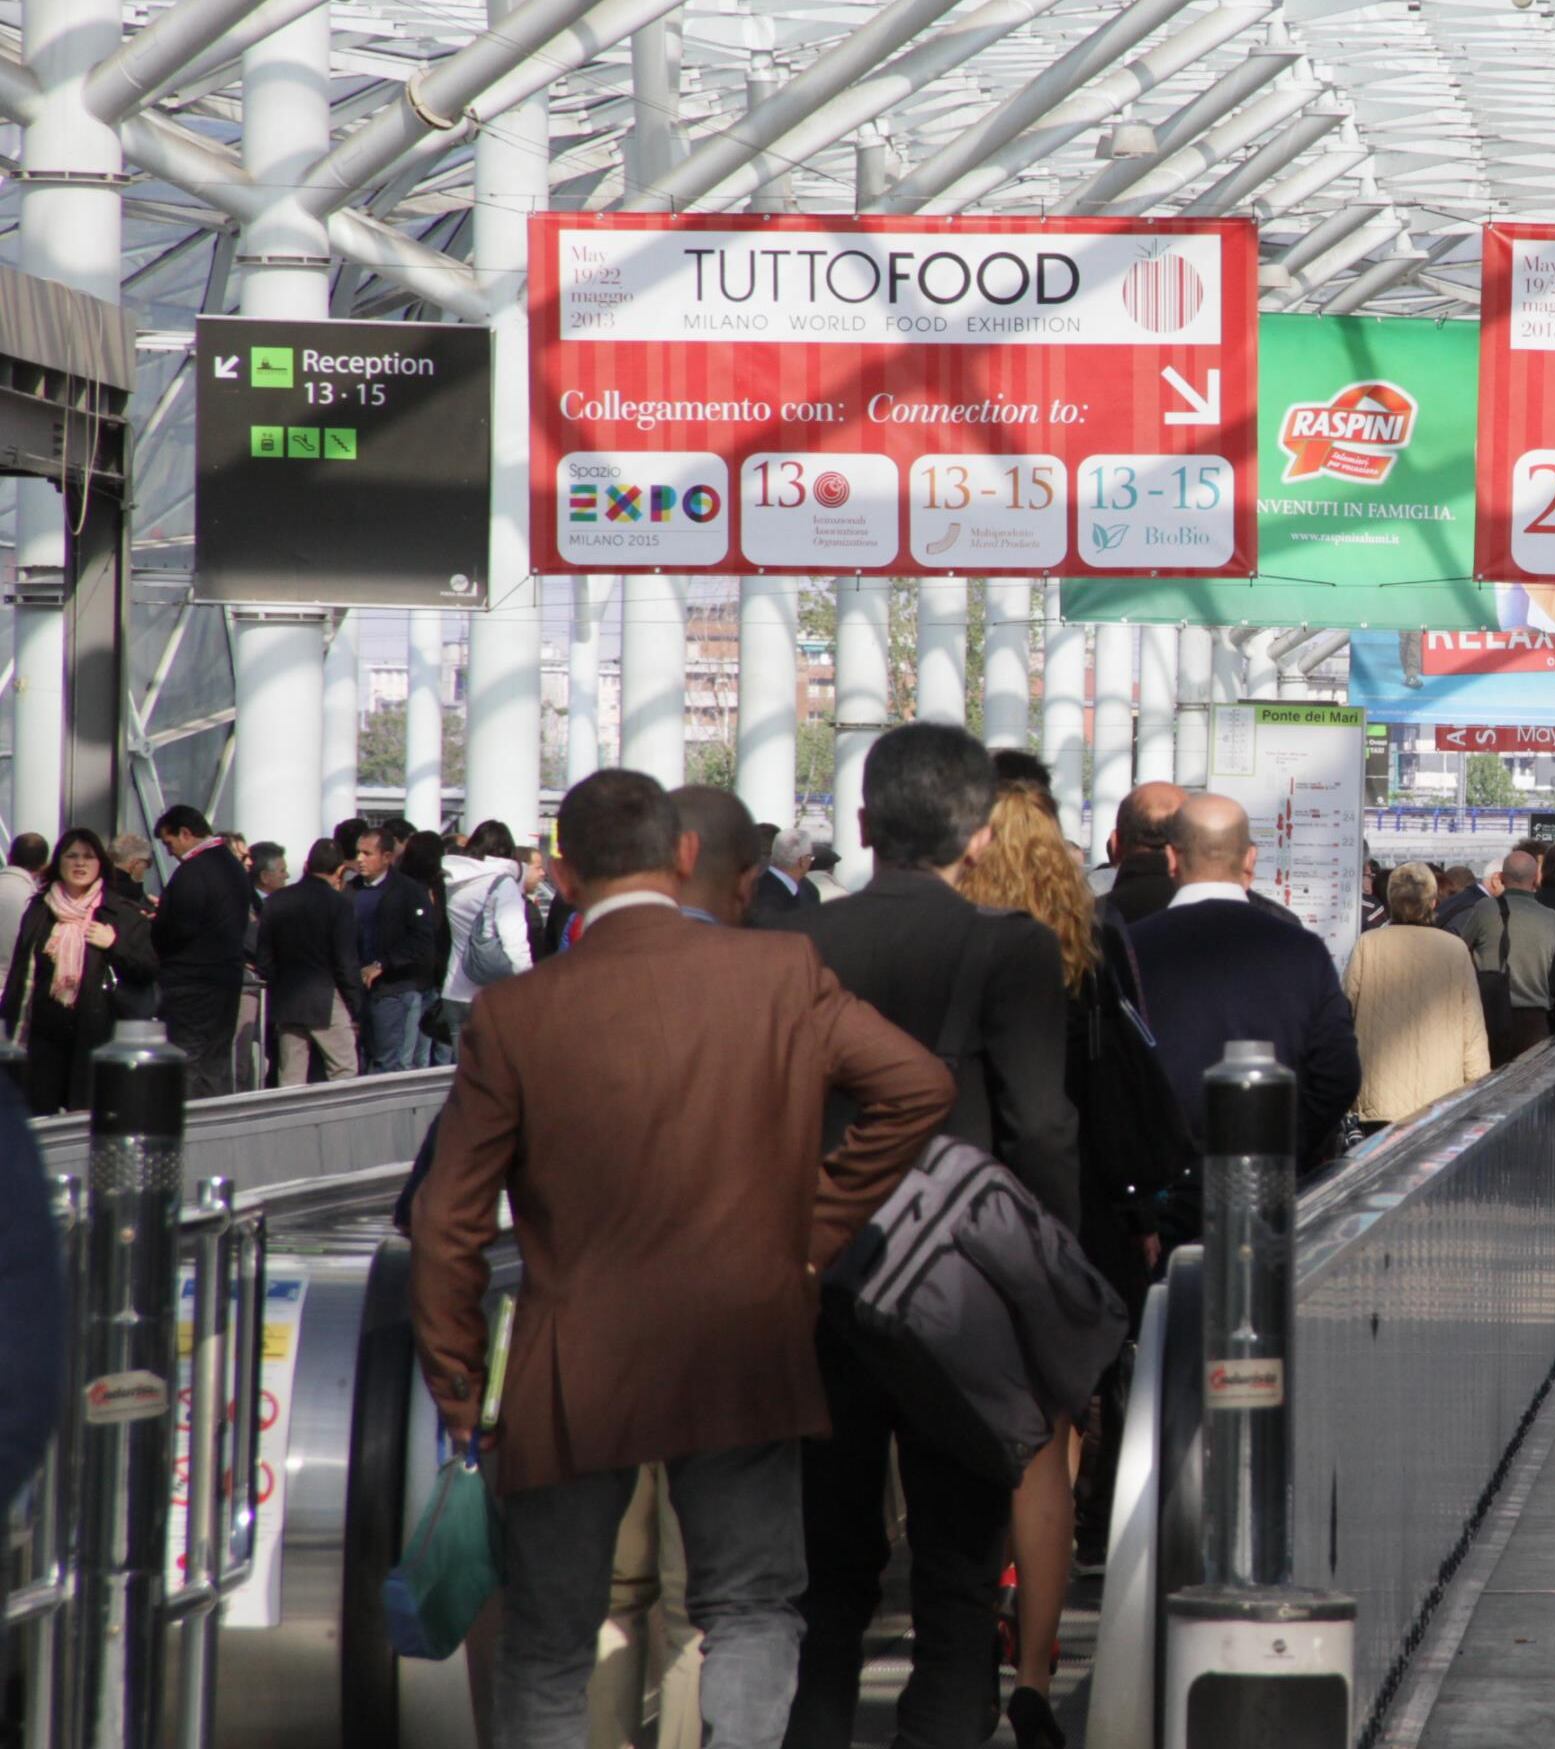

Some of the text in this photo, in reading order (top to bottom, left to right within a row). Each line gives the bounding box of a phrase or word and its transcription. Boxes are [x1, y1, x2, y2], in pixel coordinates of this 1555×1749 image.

[571, 246, 607, 264] May
[574, 267, 622, 285] 19/22
[684, 249, 1080, 305] TUTTOFOOD
[571, 287, 634, 309] maggio
[571, 312, 616, 329] 2013
[684, 315, 1081, 333] MILANO WORLD FOOD EXHIBITION
[302, 350, 434, 379] Reception
[304, 382, 334, 405] 13
[356, 384, 386, 406] 15
[560, 389, 1089, 431] Collegamento con: Connection to:
[1292, 410, 1404, 441] RASPINI
[569, 463, 621, 480] Spazio
[753, 460, 806, 508] 13
[569, 484, 721, 523] EXPO
[1343, 502, 1363, 517] IN
[1368, 503, 1456, 520] FAMIGLIA.
[569, 534, 660, 547] MILANO 2015
[1145, 526, 1210, 545] BtoBio
[1262, 709, 1300, 723] Ponte
[1305, 709, 1324, 723] dei
[1330, 710, 1358, 724] Mari
